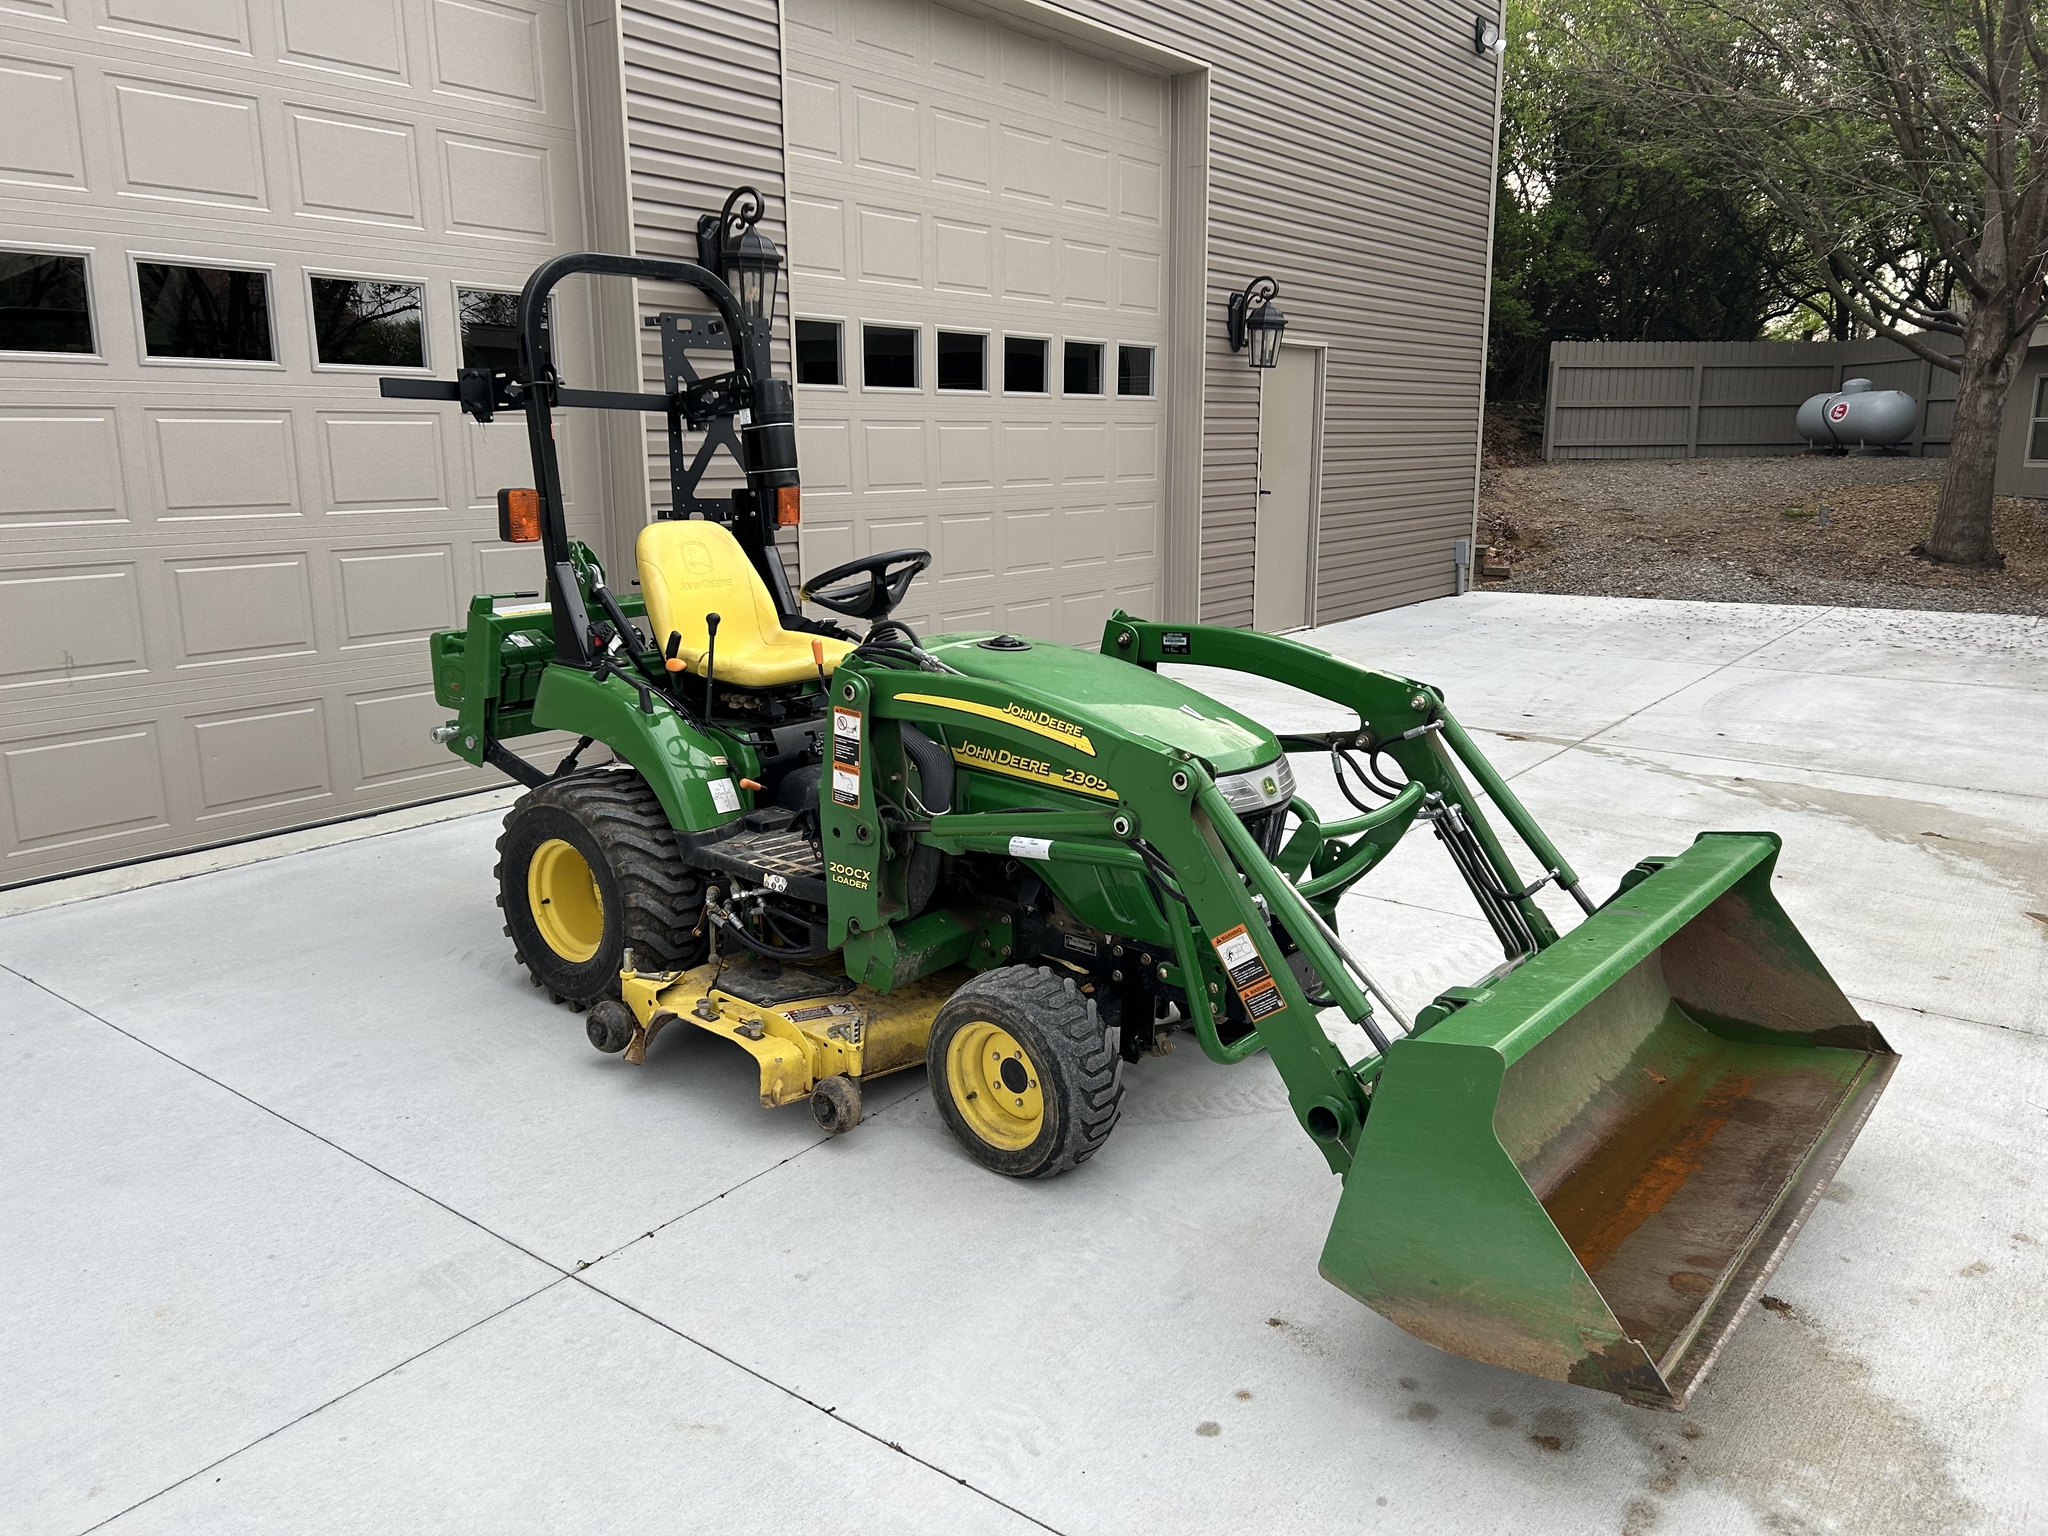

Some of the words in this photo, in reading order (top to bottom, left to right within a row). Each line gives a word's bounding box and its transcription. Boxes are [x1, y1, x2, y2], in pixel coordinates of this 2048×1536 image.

[680, 581, 701, 591] JOHN
[702, 578, 733, 589] DEERE
[1002, 701, 1038, 723] JOHN
[1038, 711, 1084, 737] DEERE
[956, 740, 997, 762] JOHN
[997, 750, 1051, 775] DEERE
[829, 861, 871, 881] 200CX
[832, 874, 868, 890] LOADER
[1221, 927, 1243, 941] WARNING
[1249, 982, 1272, 995] WARNING
